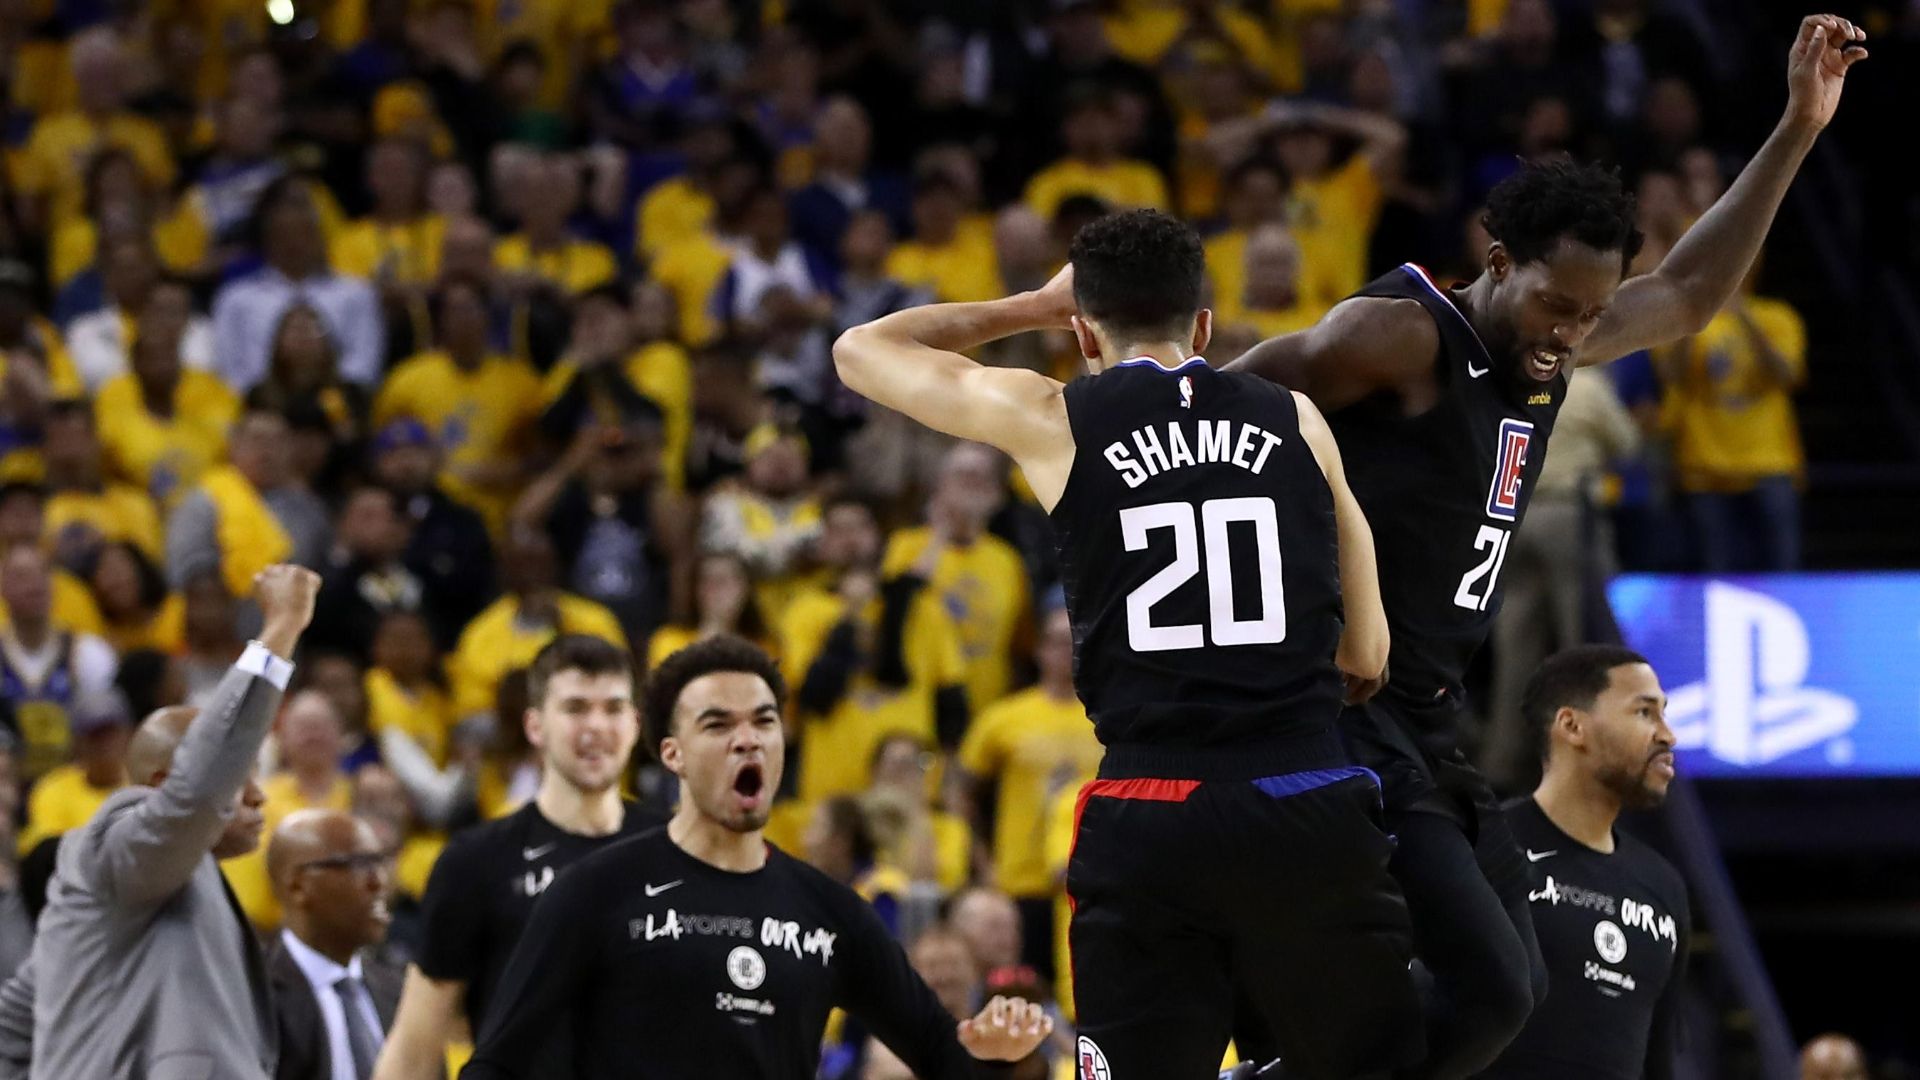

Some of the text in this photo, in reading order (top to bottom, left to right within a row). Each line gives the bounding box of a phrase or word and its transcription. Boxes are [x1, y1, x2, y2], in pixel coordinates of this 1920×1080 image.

[1103, 419, 1283, 489] SHAMET
[1119, 496, 1286, 652] 20
[760, 916, 803, 960] OUR
[1621, 897, 1660, 942] OUR
